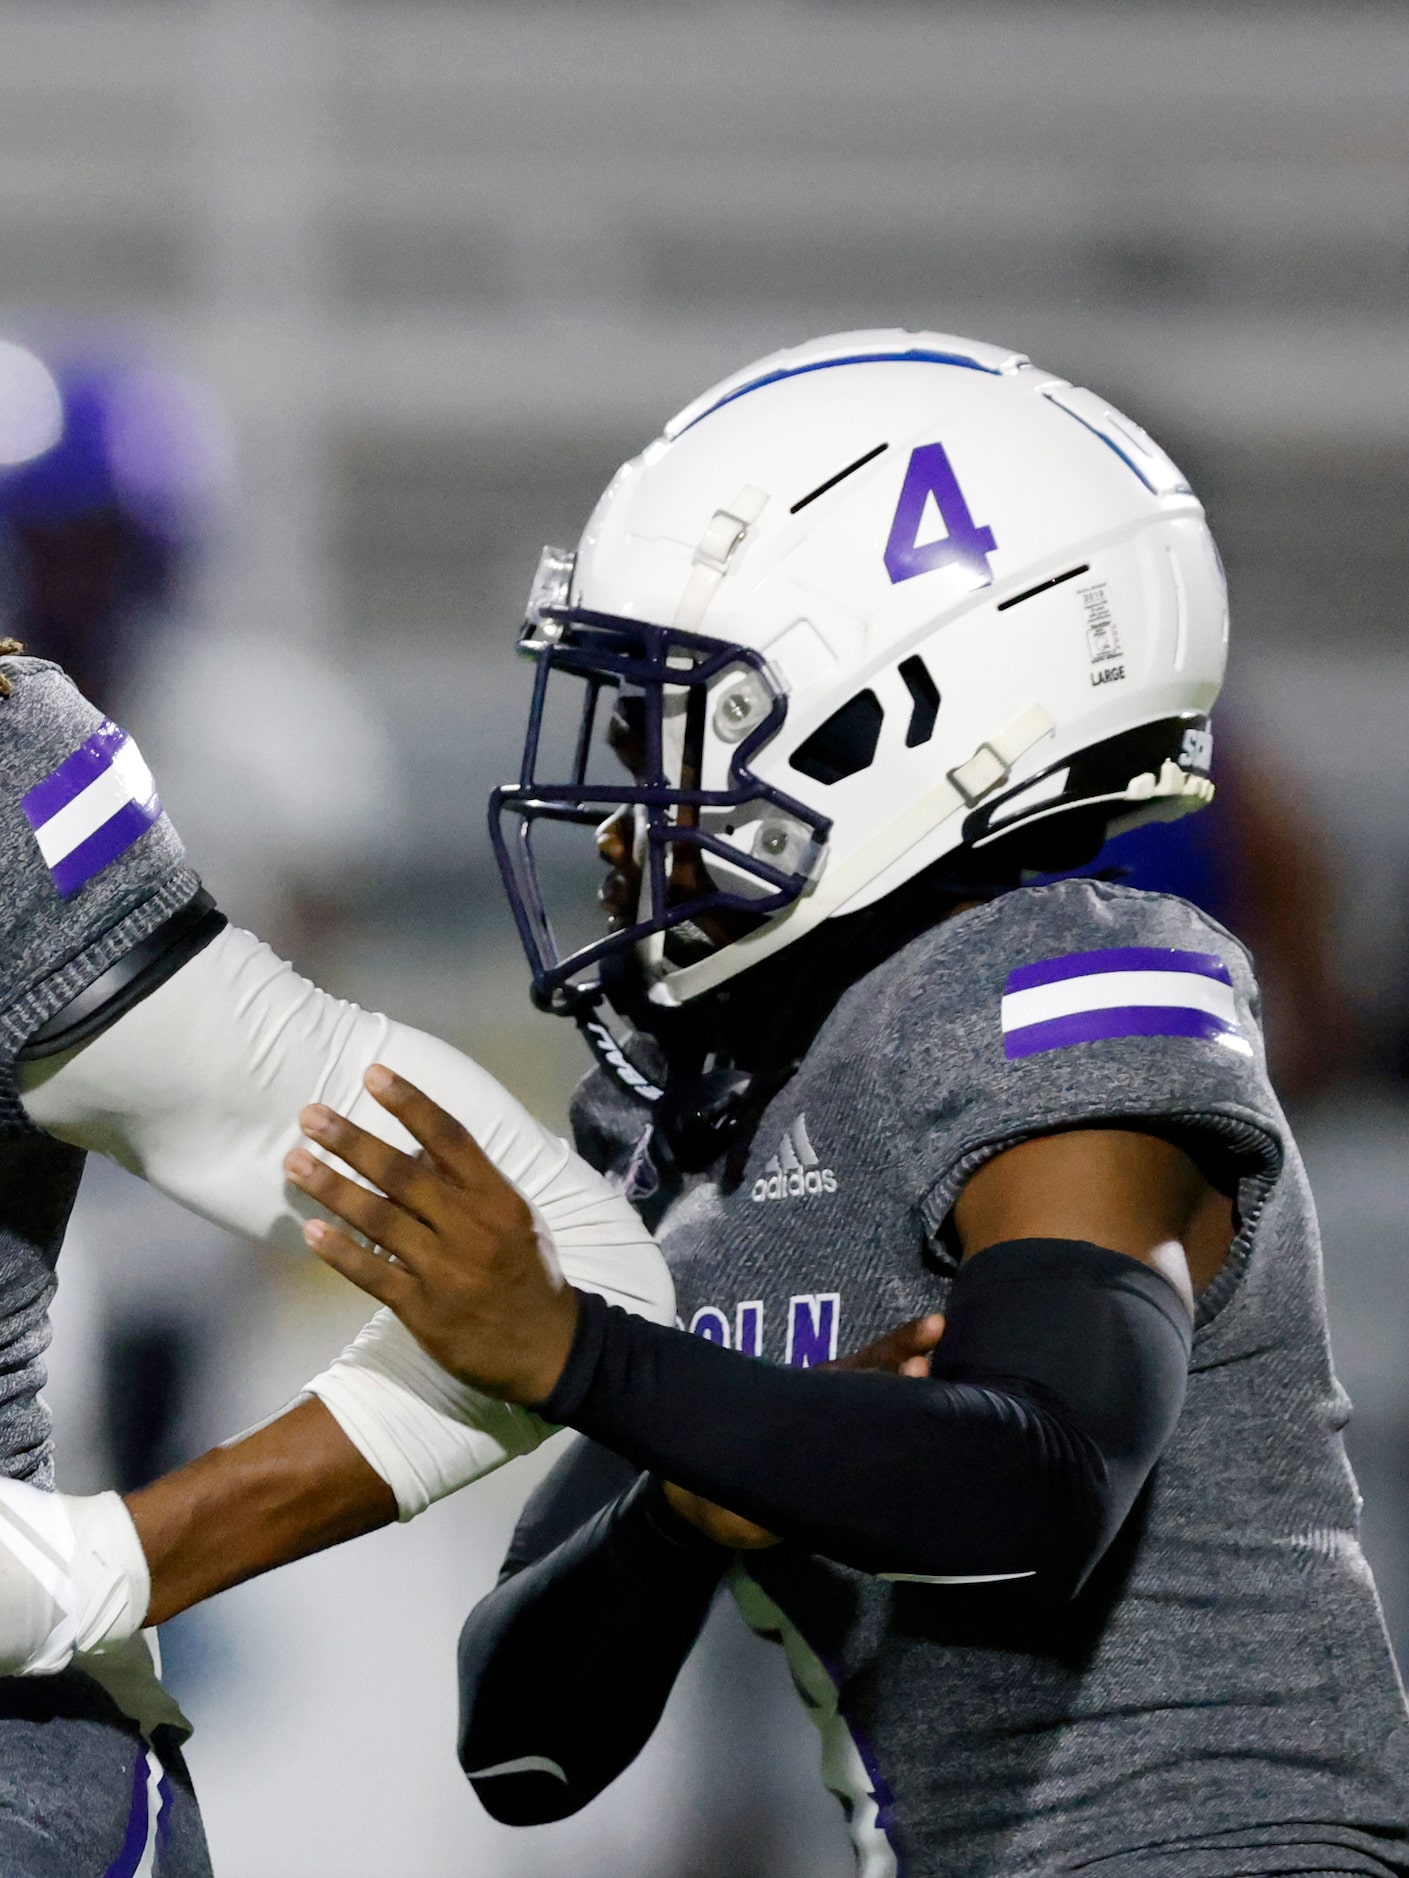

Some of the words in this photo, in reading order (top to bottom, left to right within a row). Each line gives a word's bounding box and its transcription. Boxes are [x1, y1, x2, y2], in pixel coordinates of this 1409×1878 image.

[883, 441, 998, 592] 4
[1090, 665, 1126, 687] LARGE
[752, 1164, 838, 1203] adidas
